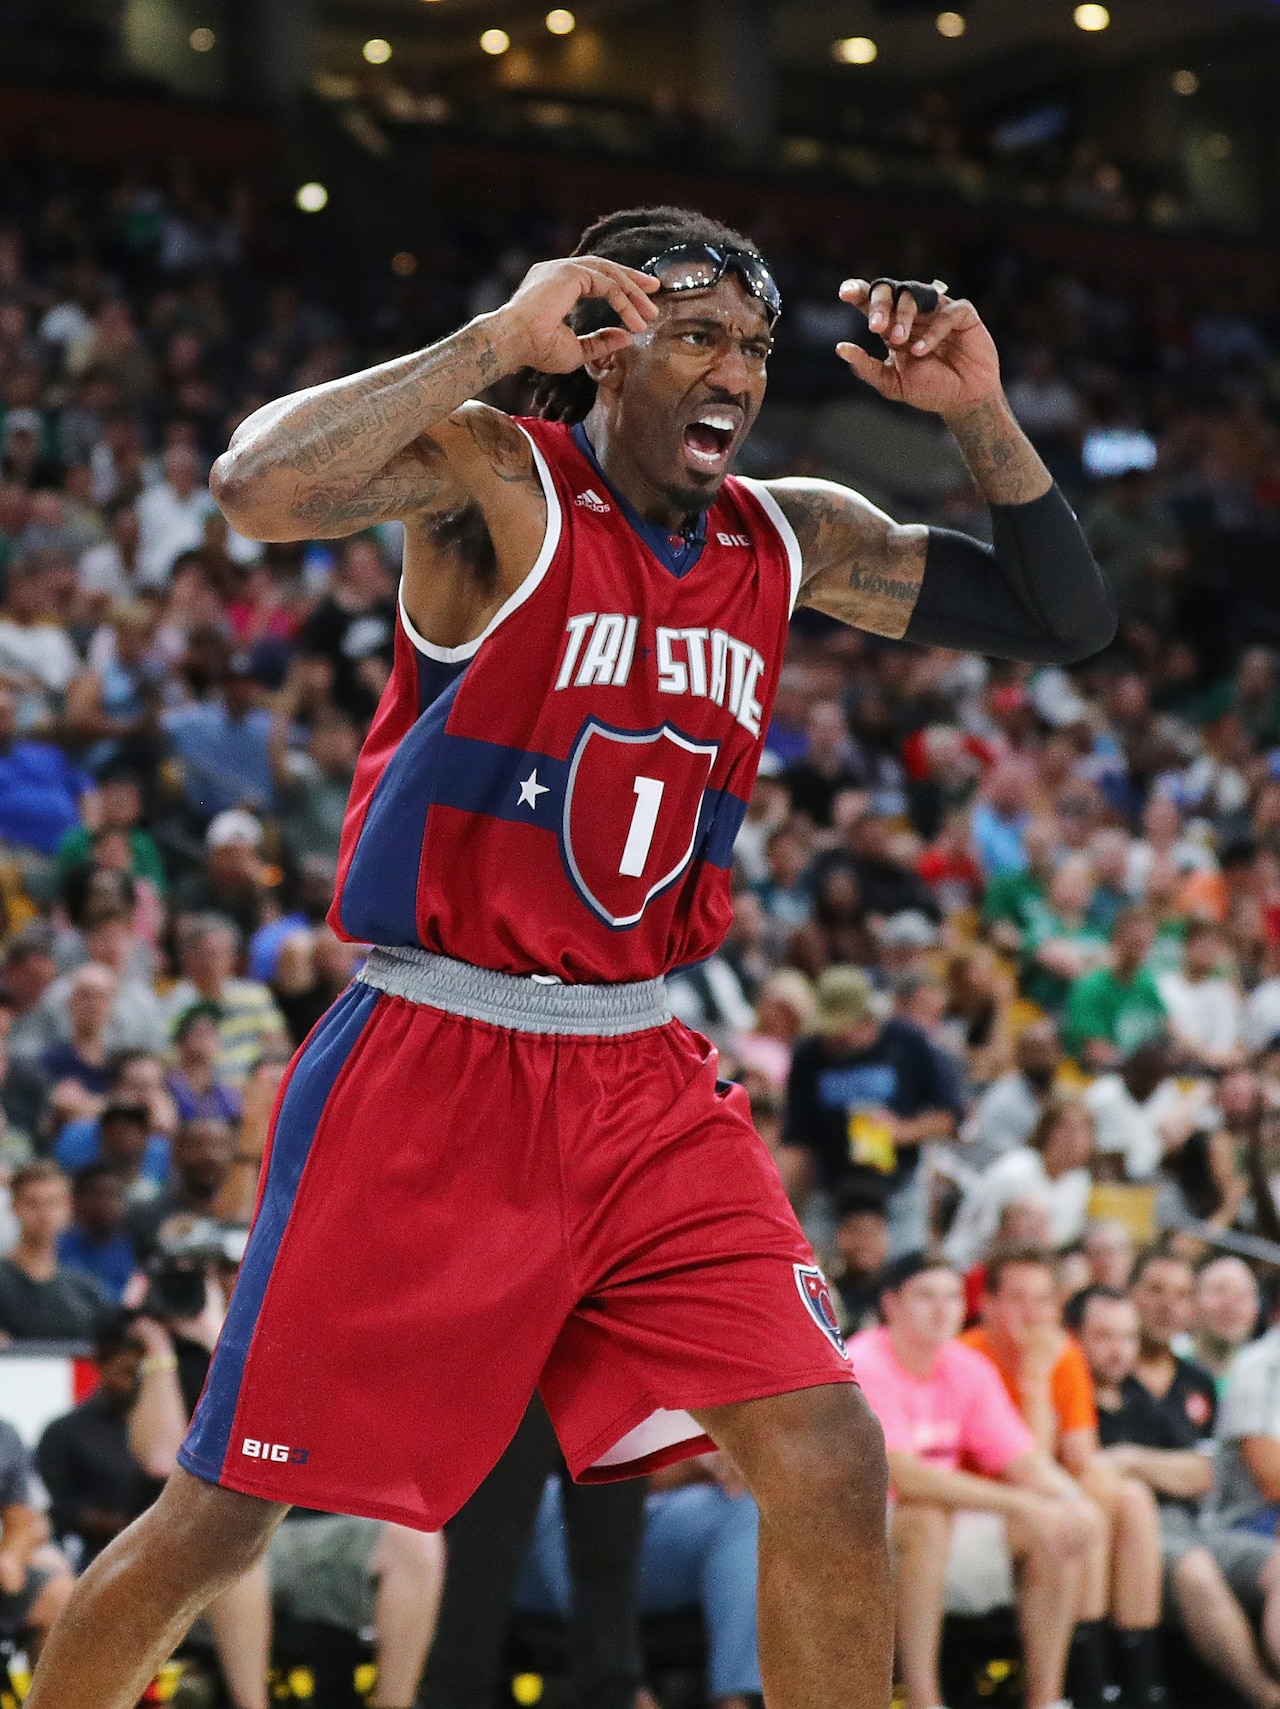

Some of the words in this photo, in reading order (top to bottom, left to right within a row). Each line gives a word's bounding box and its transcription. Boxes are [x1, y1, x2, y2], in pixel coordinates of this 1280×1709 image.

[574, 497, 611, 513] adidas
[554, 611, 640, 692] TRI
[655, 625, 765, 741] STATE
[618, 775, 665, 878] 1
[241, 1437, 310, 1466] BIG3
